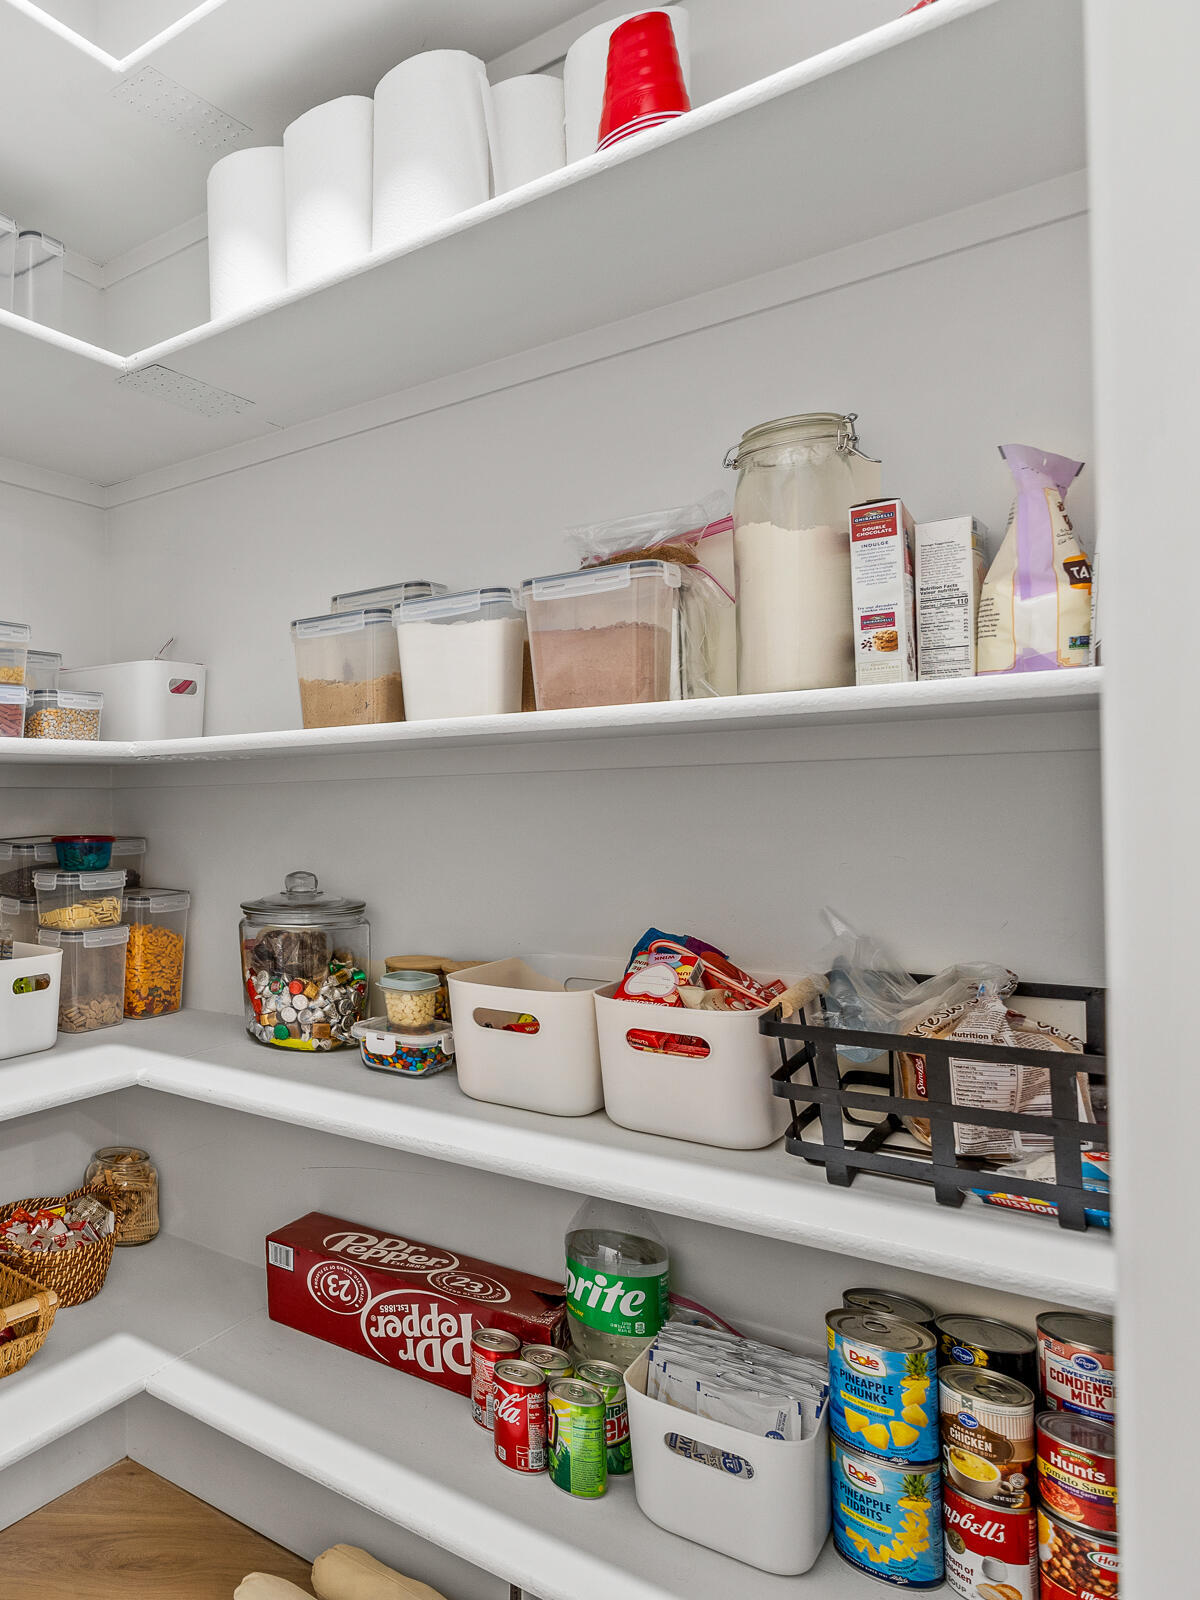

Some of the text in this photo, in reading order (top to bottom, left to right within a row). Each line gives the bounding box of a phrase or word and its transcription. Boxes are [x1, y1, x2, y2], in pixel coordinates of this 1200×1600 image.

[856, 528, 893, 537] CHOCOLATE
[862, 524, 887, 532] DOUBLE
[951, 1032, 989, 1041] Nutrition
[328, 1234, 450, 1268] Pepper
[373, 1237, 429, 1253] Dr
[326, 1274, 353, 1302] 23
[449, 1276, 485, 1293] 23
[399, 1338, 445, 1373] Dr
[849, 1349, 880, 1368] Dole
[1075, 1356, 1098, 1369] Kroger
[840, 1368, 895, 1396] PINEAPPLE
[1049, 1366, 1115, 1398] CONDENS
[1061, 1366, 1113, 1386] SWEETENED
[844, 1382, 888, 1405] CHUNKS
[1070, 1388, 1106, 1410] MILK
[953, 1423, 976, 1437] CREAM
[958, 1413, 978, 1427] Kroger
[949, 1426, 993, 1453] CHICKEN
[848, 1463, 877, 1485] Dole
[1042, 1460, 1117, 1498] Tomato Sauce
[839, 1480, 892, 1514] PINEAPPLE
[845, 1495, 883, 1522] TIDBITS
[943, 1502, 1006, 1543] mpbell's
[964, 1567, 975, 1577] of
